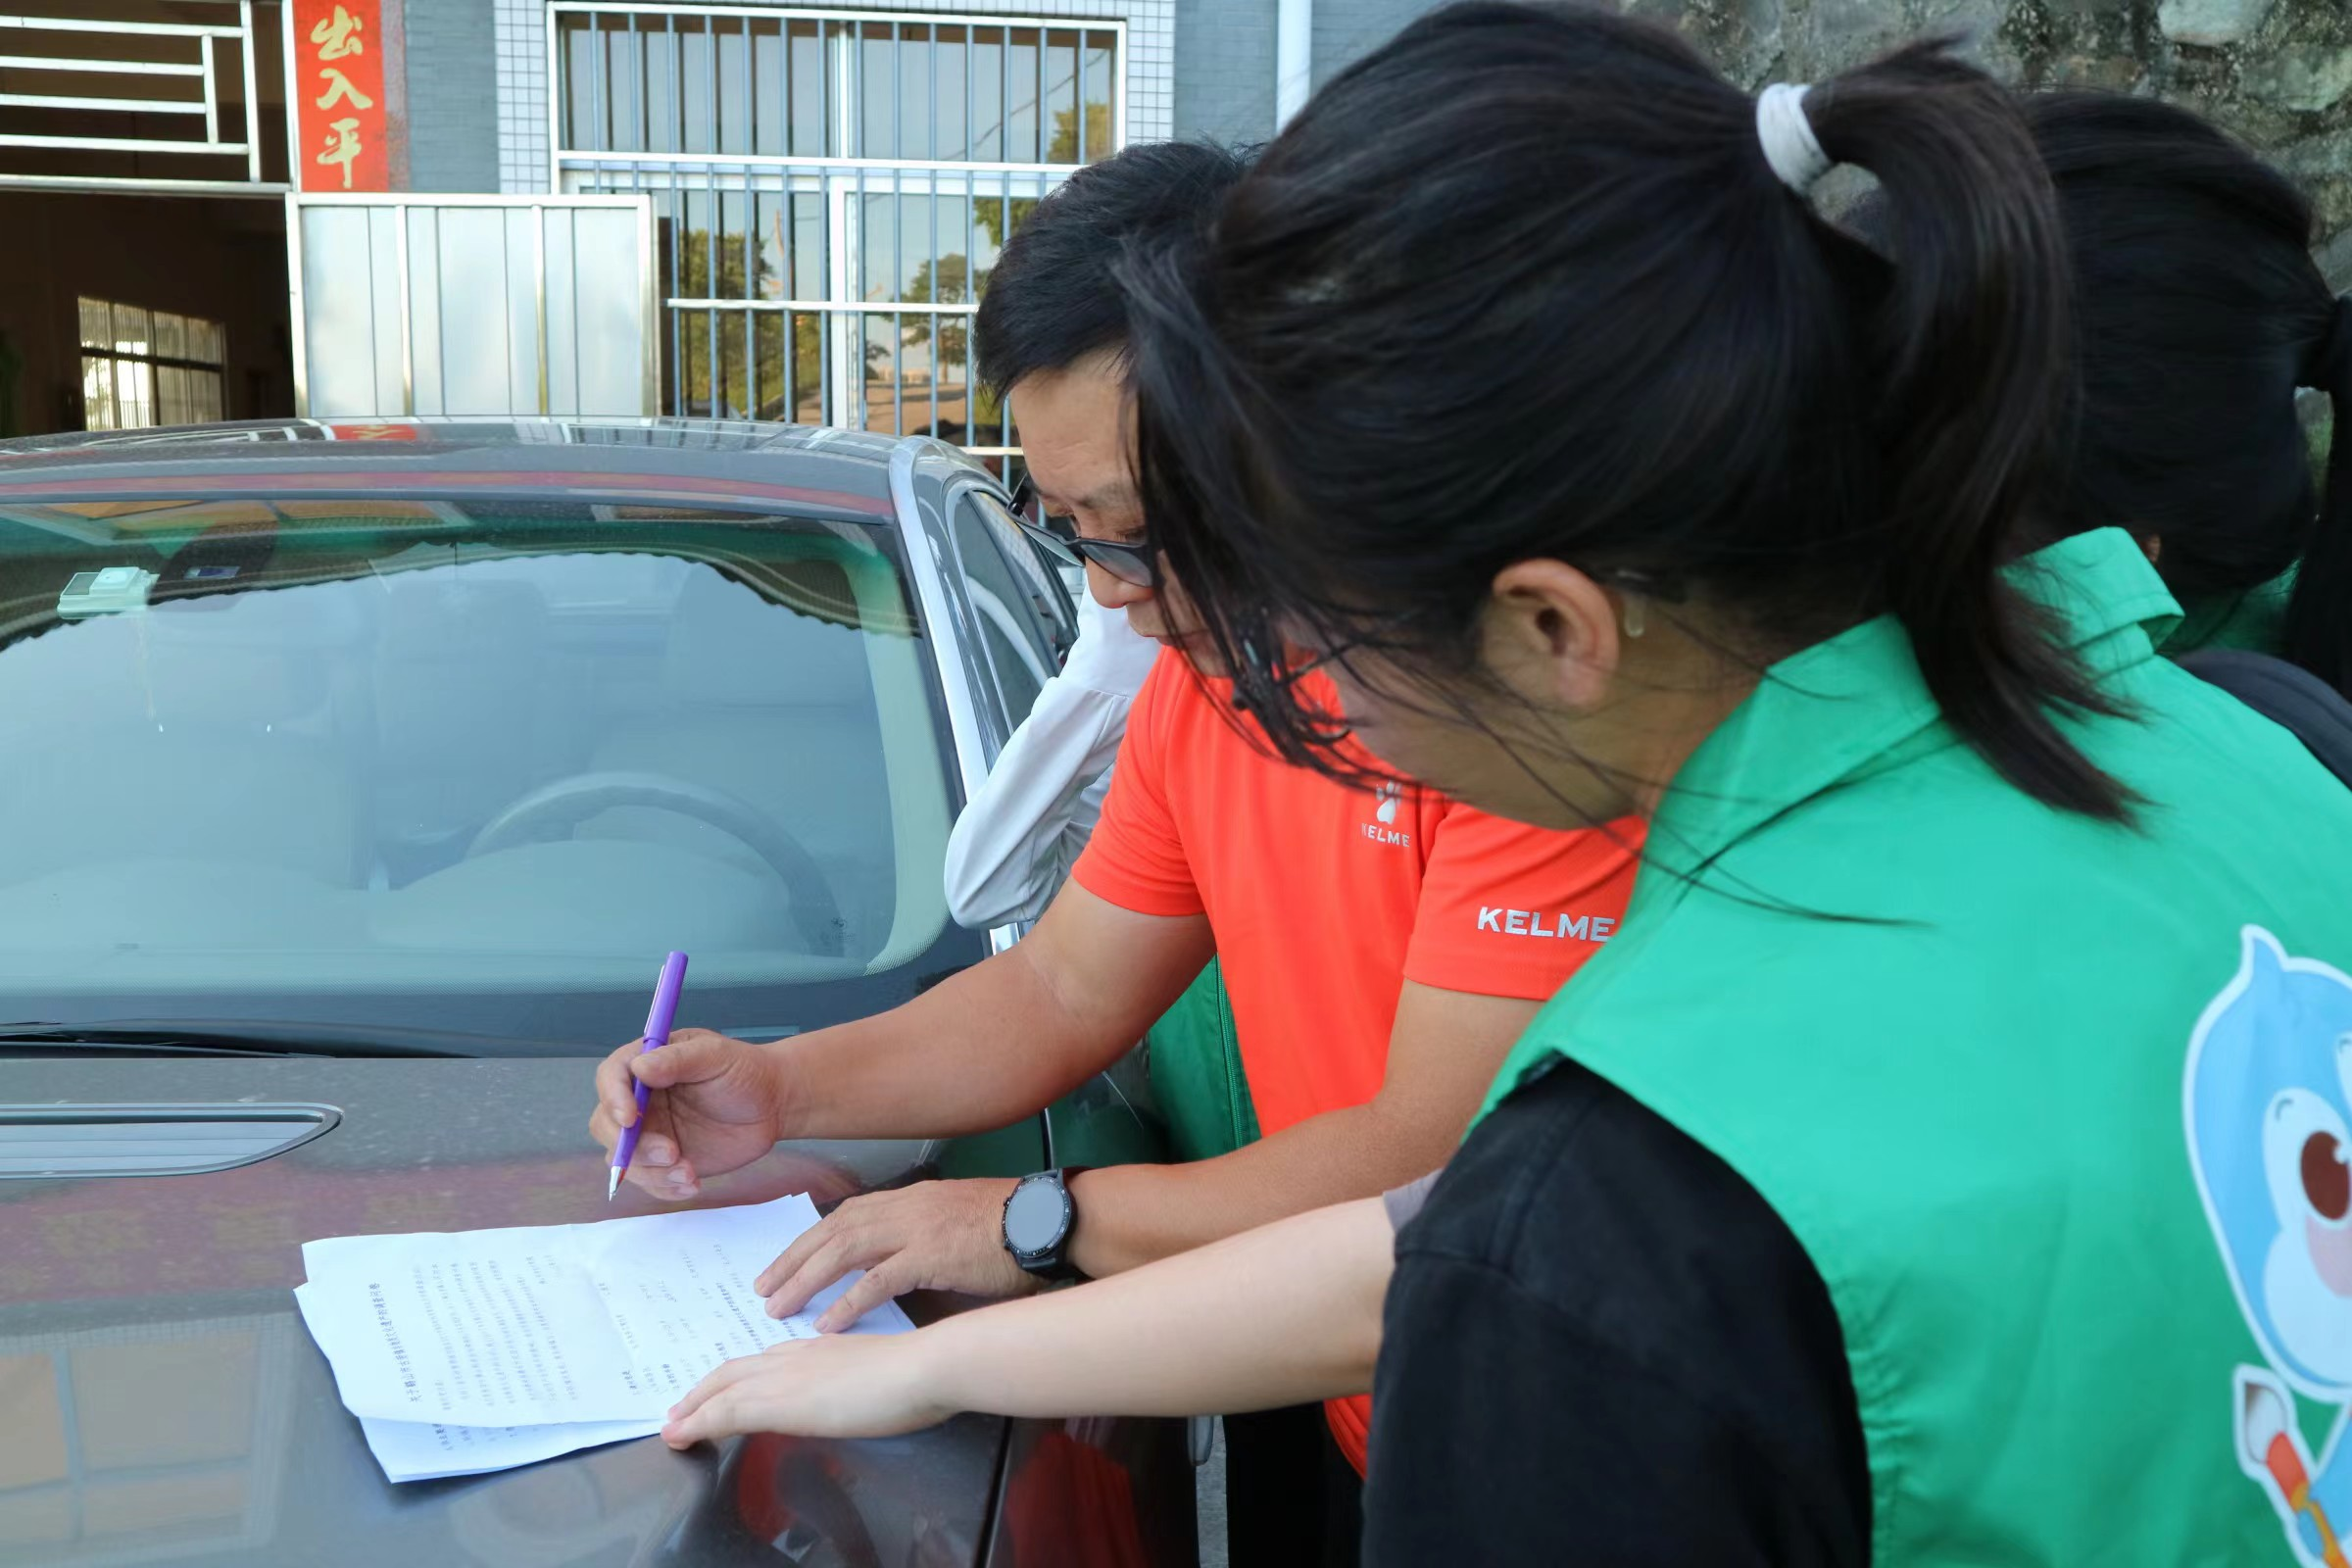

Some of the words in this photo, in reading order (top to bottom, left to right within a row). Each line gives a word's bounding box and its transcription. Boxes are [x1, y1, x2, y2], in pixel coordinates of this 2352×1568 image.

[310, 5, 373, 189] 出入平
[1477, 906, 1616, 943] KELME
